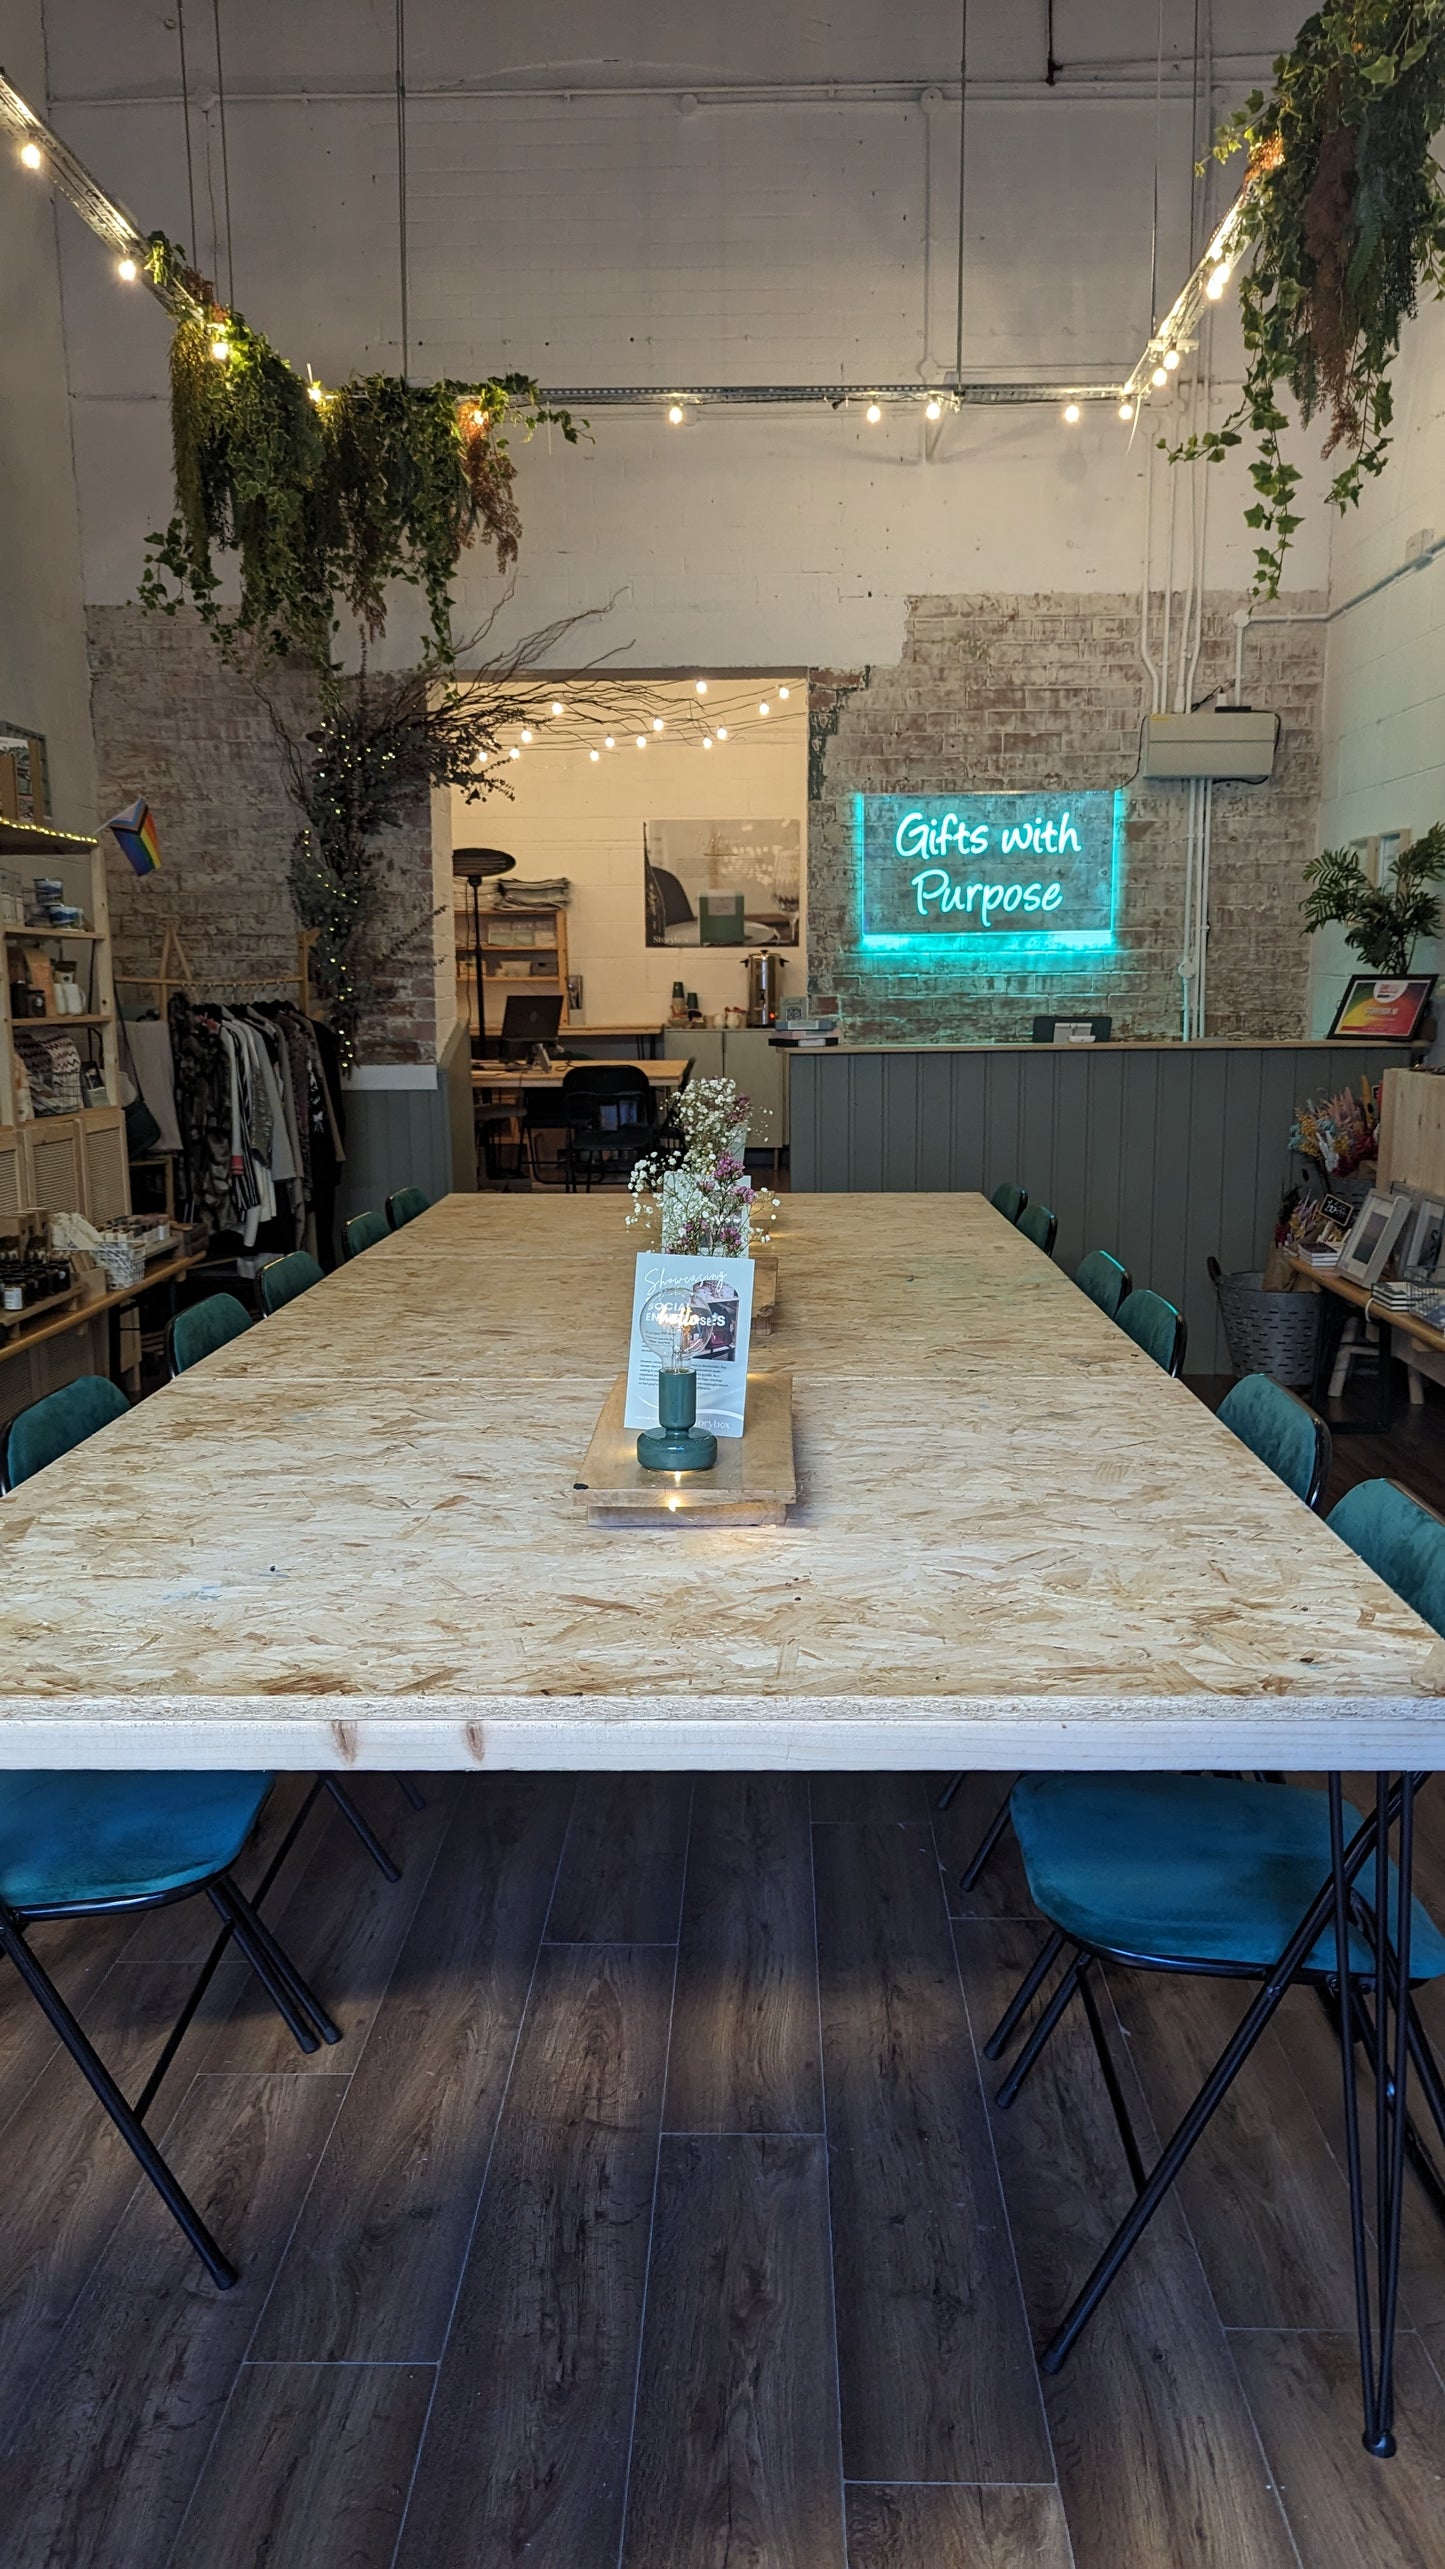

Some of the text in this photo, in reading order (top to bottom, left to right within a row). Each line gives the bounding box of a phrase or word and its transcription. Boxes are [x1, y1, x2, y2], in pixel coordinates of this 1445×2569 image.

[895, 811, 1082, 860] Gifts with
[911, 868, 1064, 928] Purpose
[644, 1266, 728, 1299] Showcasing
[697, 1418, 731, 1430] orybox
